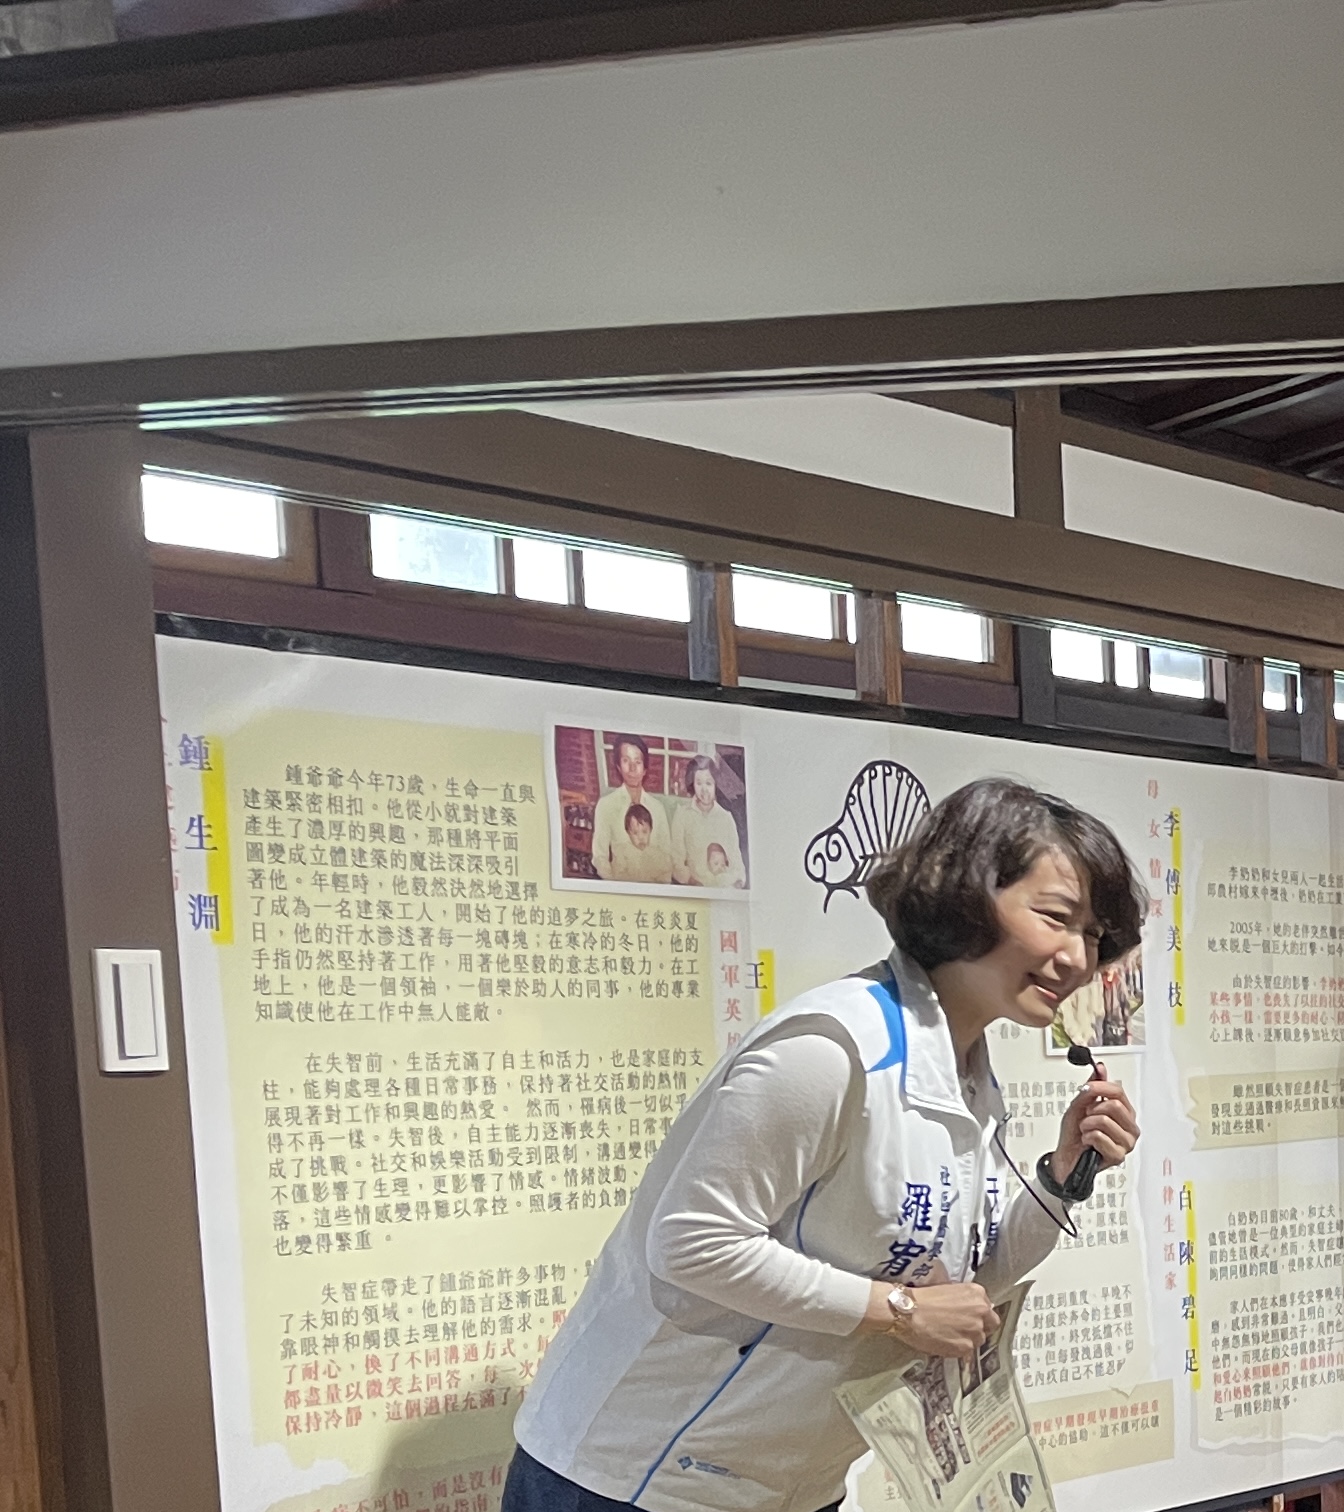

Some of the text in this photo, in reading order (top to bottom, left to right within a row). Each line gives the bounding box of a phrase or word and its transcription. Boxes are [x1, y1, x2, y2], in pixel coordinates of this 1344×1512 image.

[268, 1139, 664, 1179] 成了挑戰。社交和娛樂活動受到限制，溝通變得
[284, 1359, 540, 1410] 都盡量以微笑去回答，每一次
